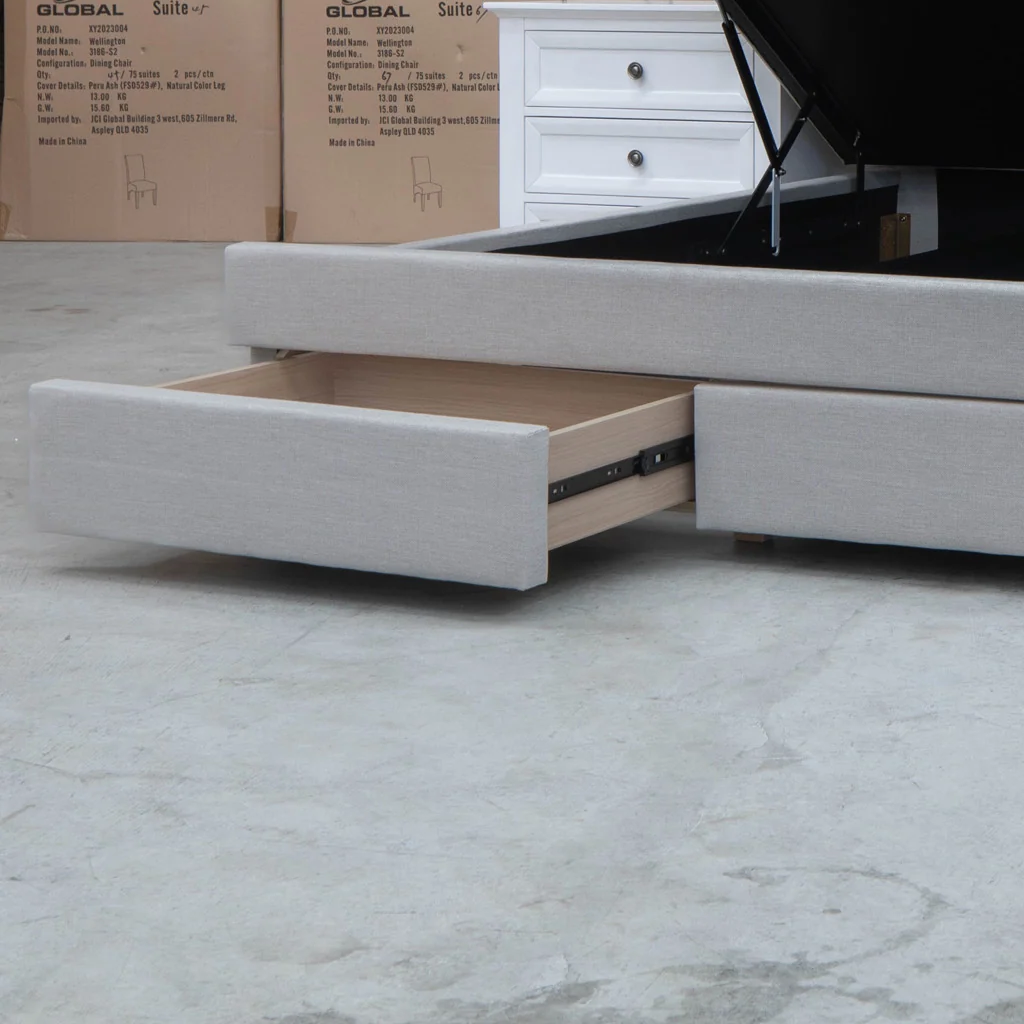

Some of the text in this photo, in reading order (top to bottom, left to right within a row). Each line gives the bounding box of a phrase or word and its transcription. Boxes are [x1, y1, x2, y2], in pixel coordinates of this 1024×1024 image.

[36, 2, 124, 16] GLOBAL
[325, 4, 411, 18] GLOBAL
[89, 24, 129, 33] XY2023004
[377, 49, 405, 57] 3186-S2
[90, 59, 133, 69] Dining Chair
[379, 127, 434, 137] Aspley QLD 4035
